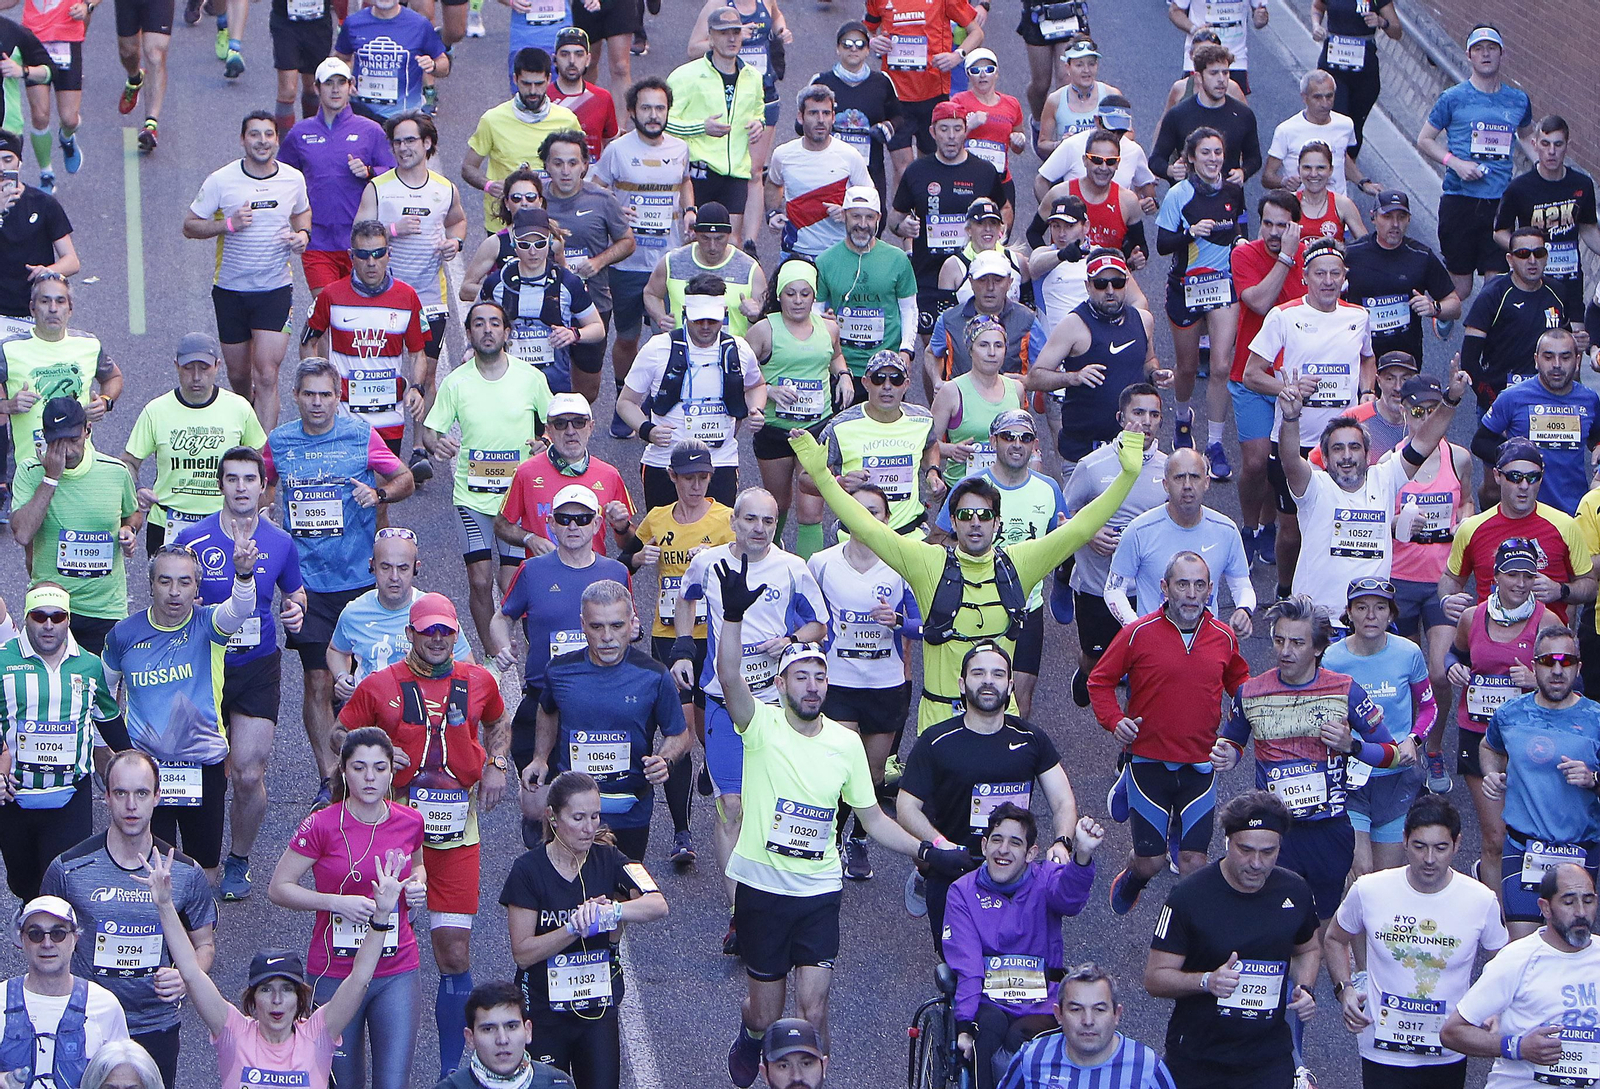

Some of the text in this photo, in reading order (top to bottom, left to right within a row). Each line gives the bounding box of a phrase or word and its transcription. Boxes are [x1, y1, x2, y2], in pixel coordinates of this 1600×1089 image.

[893, 10, 926, 21] MARTIN
[1340, 38, 1361, 46] ZURICH
[739, 47, 762, 55] ZURICH
[1485, 124, 1509, 132] ZURICH
[841, 135, 867, 143] ZURICH
[977, 141, 1001, 151] ZURICH
[637, 183, 673, 192] MARATON
[644, 197, 671, 205] ZURICH
[643, 210, 662, 219] 9027
[940, 216, 966, 224] ZURICH
[1552, 244, 1574, 252] ZURICH
[1199, 274, 1223, 284] ZURICH
[1198, 287, 1219, 296] 11137
[1377, 297, 1404, 306] ZURICH
[852, 308, 879, 317] ZURICH
[1376, 310, 1399, 320] 12744
[850, 324, 873, 332] 10726
[519, 329, 548, 338] ZURICH
[849, 333, 872, 341] CAPITÁN
[519, 345, 542, 353] 11138
[1318, 365, 1346, 373] ZURICH
[365, 371, 392, 379] ZURICH
[363, 385, 386, 394] 11766
[1318, 381, 1337, 389] 9060
[1545, 405, 1574, 414] ZURICH
[701, 421, 720, 430] 8721
[1546, 421, 1566, 430] 4093
[694, 431, 725, 440] ESCAMILLA
[172, 429, 226, 456] boyer
[862, 438, 916, 453] MOROCCO
[305, 452, 323, 460] EDP
[485, 452, 515, 460] ZURICH
[182, 456, 220, 470] medi
[880, 457, 908, 466] ZURICH
[484, 467, 506, 476] 5552
[879, 474, 899, 483] 7760
[304, 490, 335, 500] ZURICH
[1418, 493, 1448, 503] ZURICH
[305, 508, 327, 518] 9395
[1351, 512, 1381, 521] ZURICH
[78, 532, 109, 541] ZURICH
[1348, 529, 1373, 538] 10527
[1356, 541, 1378, 549] FARFAN
[75, 548, 100, 557] 11999
[63, 561, 108, 569] CARLOS VIEIRA
[206, 569, 224, 577] Kineti
[764, 587, 781, 602] 30
[876, 586, 892, 598] 20
[853, 630, 881, 640] 11065
[855, 641, 877, 650] MARTA
[6, 663, 35, 672] macron
[746, 660, 768, 672] 9010
[130, 662, 193, 687] TUSSAM
[1481, 695, 1507, 704] 11241
[38, 723, 72, 732] ZURICH
[589, 732, 624, 743] ZURICH
[35, 742, 64, 752] 10704
[38, 755, 59, 763] MORA
[587, 751, 616, 762] 10646
[161, 760, 195, 768] ZURICH
[588, 764, 614, 772] CUEVAS
[1282, 764, 1317, 778] ZURICH
[992, 783, 1024, 795] ZURICH
[1283, 783, 1312, 797] 10514
[430, 790, 462, 801] ZURICH
[1295, 795, 1320, 806] PUENTE
[428, 810, 452, 821] 9825
[797, 805, 830, 819] ZURICH
[425, 823, 452, 832] ROBERT
[789, 823, 818, 839] 10320
[788, 838, 810, 849] JAIME
[1545, 845, 1580, 856] ZURICH
[116, 887, 153, 900] Reekm
[1393, 914, 1417, 925] #YO
[119, 923, 156, 935] ZURICH
[1393, 924, 1415, 935] SOY
[1374, 931, 1456, 947] SHERRYRUNNER
[117, 945, 143, 955] 9794
[116, 958, 141, 967] KINETI
[569, 953, 604, 965] ZURICH
[1003, 957, 1038, 969] ZURICH
[1244, 962, 1280, 974] ZURICH
[1007, 977, 1024, 988] 172
[573, 989, 592, 998] ANNE
[1003, 990, 1027, 998] PEDRO
[1241, 984, 1268, 995] 8728
[1240, 997, 1264, 1007] CHINO
[1400, 1001, 1439, 1013] ZURICH
[1397, 1020, 1424, 1032] 9317
[1392, 1031, 1426, 1044] TÍO PEPE
[1561, 1029, 1594, 1041] ZURICH
[1548, 1064, 1588, 1076] CARLOS DR
[263, 1072, 303, 1085] ZURICH
